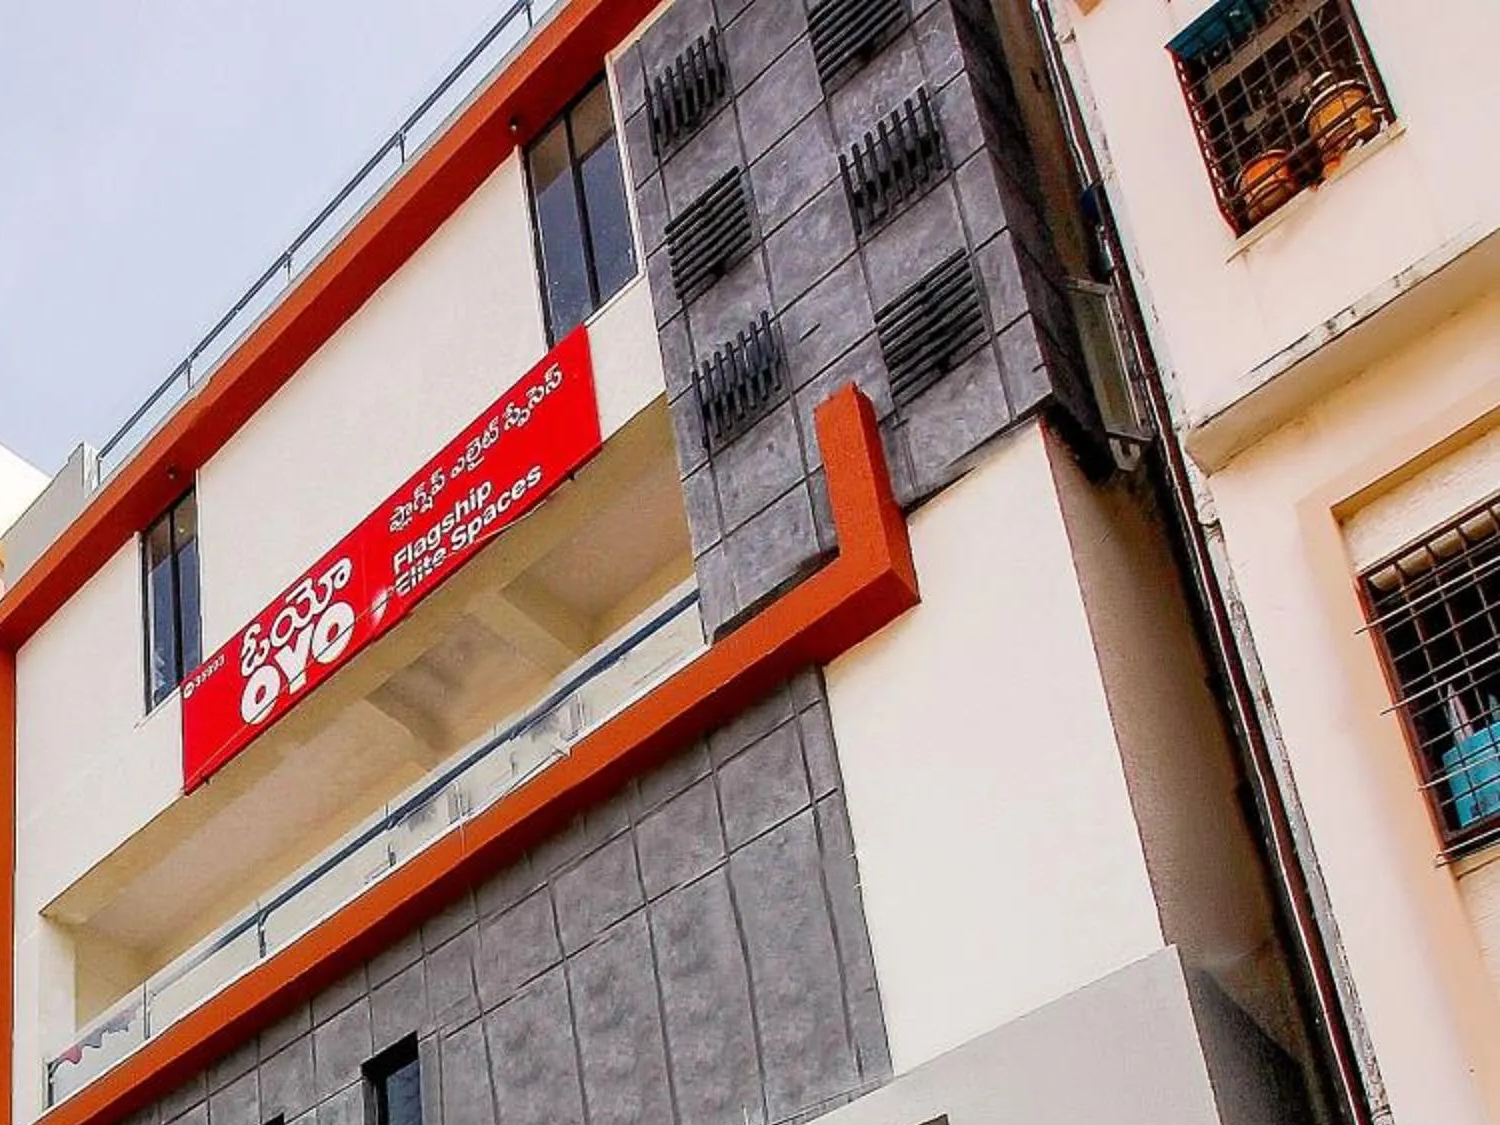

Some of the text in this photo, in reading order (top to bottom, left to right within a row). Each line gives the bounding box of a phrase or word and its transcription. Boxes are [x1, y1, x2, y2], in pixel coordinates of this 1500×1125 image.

[393, 481, 492, 575] Flagship
[395, 465, 543, 596] Elite Spaces
[240, 557, 352, 677] ఓయో
[241, 601, 356, 725] OYO
